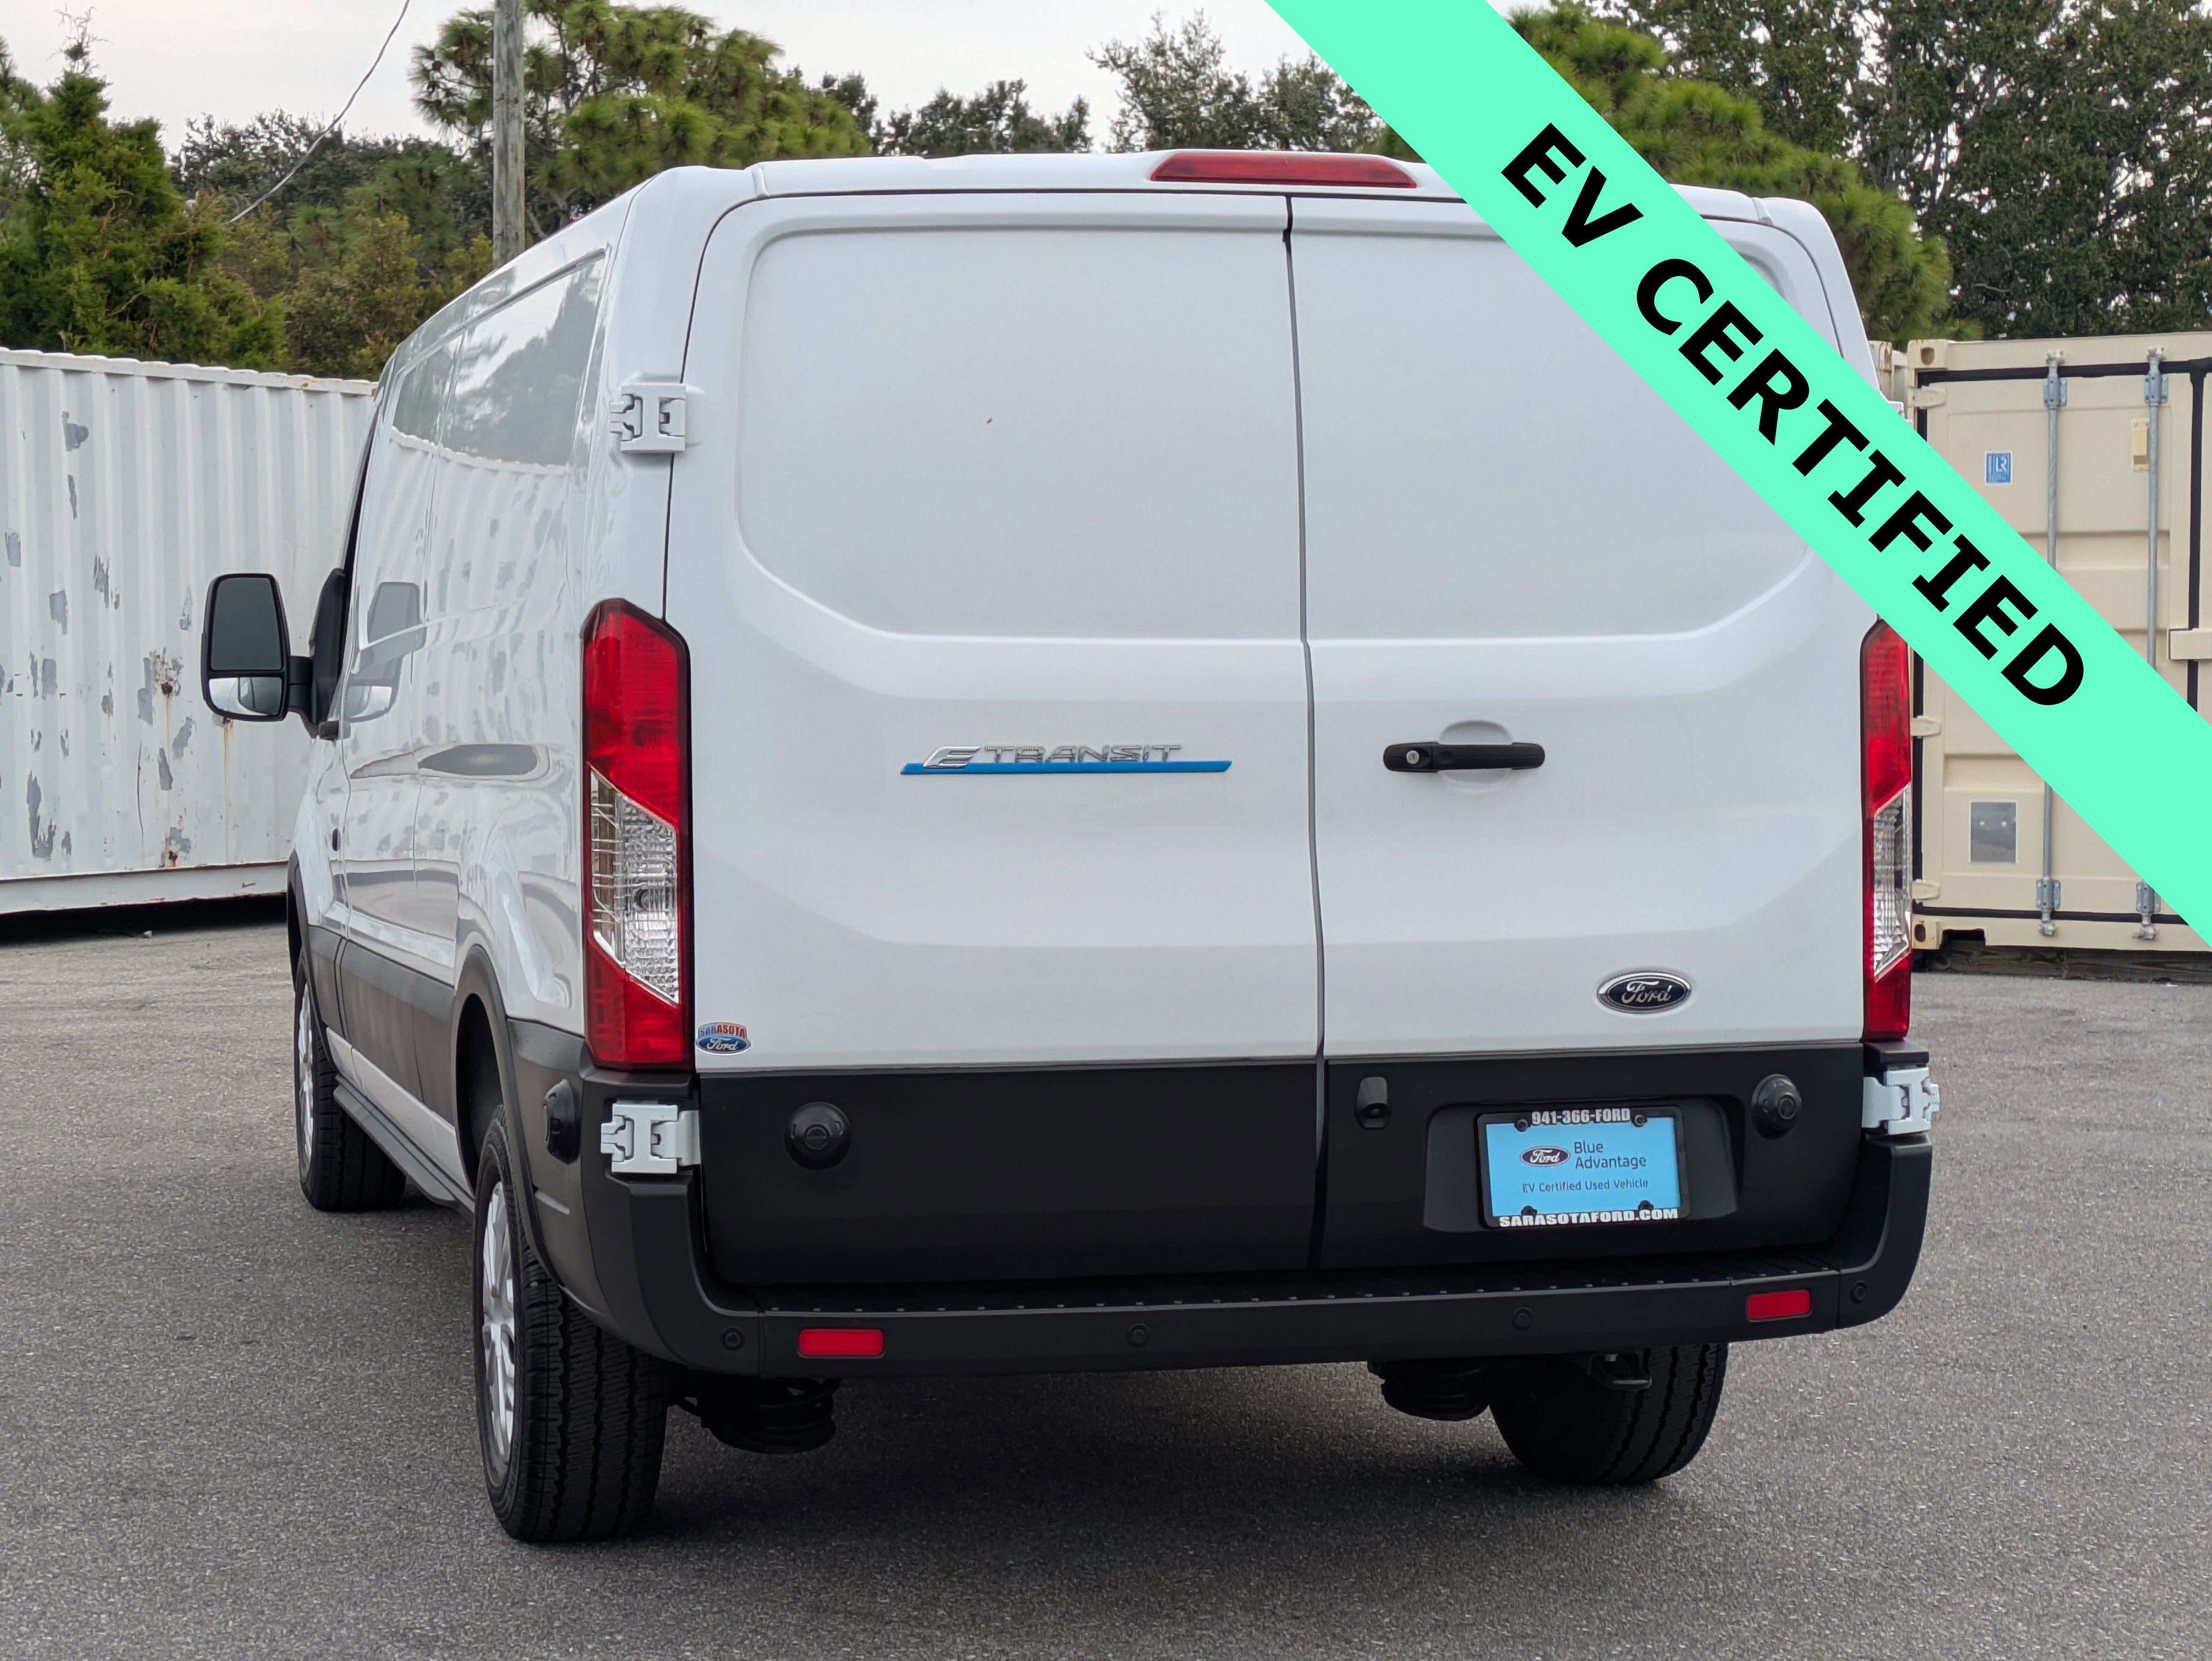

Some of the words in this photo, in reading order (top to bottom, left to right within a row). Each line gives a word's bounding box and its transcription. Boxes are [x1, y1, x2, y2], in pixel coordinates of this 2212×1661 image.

[984, 744, 1181, 763] TRANSIT
[1621, 980, 1673, 1004] Ford
[699, 1024, 745, 1038] SARASOTA
[706, 1037, 738, 1051] Ford
[1531, 1107, 1631, 1125] 941-366-FORD
[1574, 1141, 1604, 1154] Blue
[1529, 1149, 1560, 1163] Ford
[1575, 1155, 1647, 1170] Advantage
[1522, 1183, 1535, 1193] EV
[1538, 1180, 1582, 1192] Certified
[1585, 1179, 1610, 1190] Used
[1613, 1178, 1648, 1189] Vehicle
[1499, 1208, 1679, 1228] SARASOTAFORD.COM
